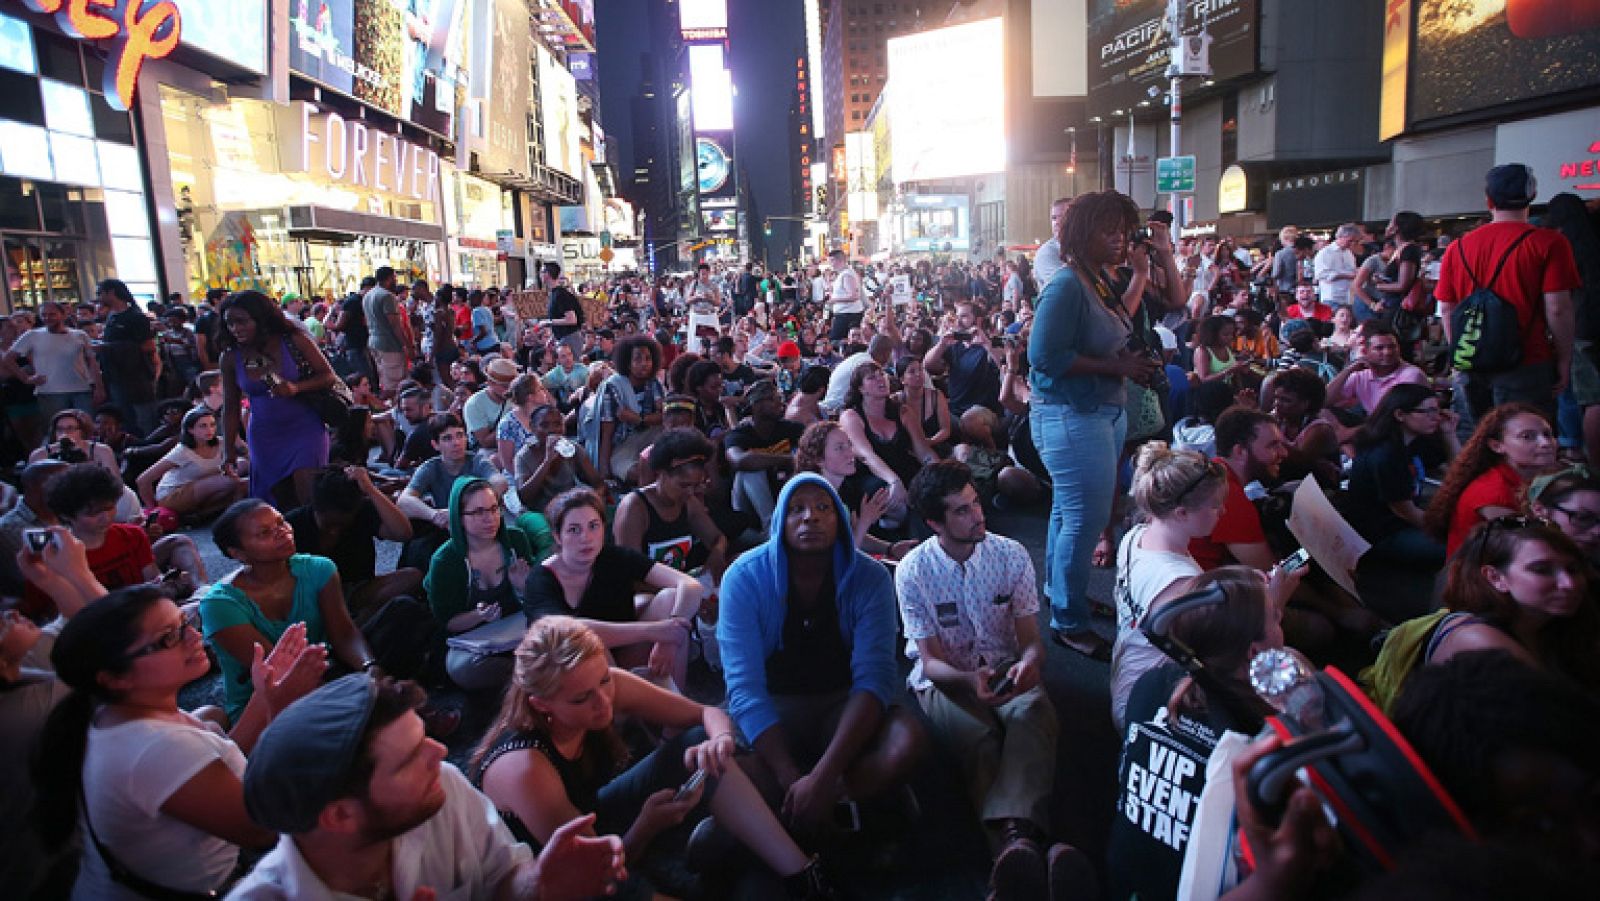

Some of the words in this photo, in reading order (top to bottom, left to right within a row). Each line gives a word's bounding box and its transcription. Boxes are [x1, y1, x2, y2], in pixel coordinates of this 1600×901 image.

[1559, 158, 1600, 180] NE
[1272, 170, 1360, 192] MARQUIS
[562, 242, 601, 260] SW
[1149, 741, 1197, 785] VIP
[1124, 793, 1191, 852] STAF
